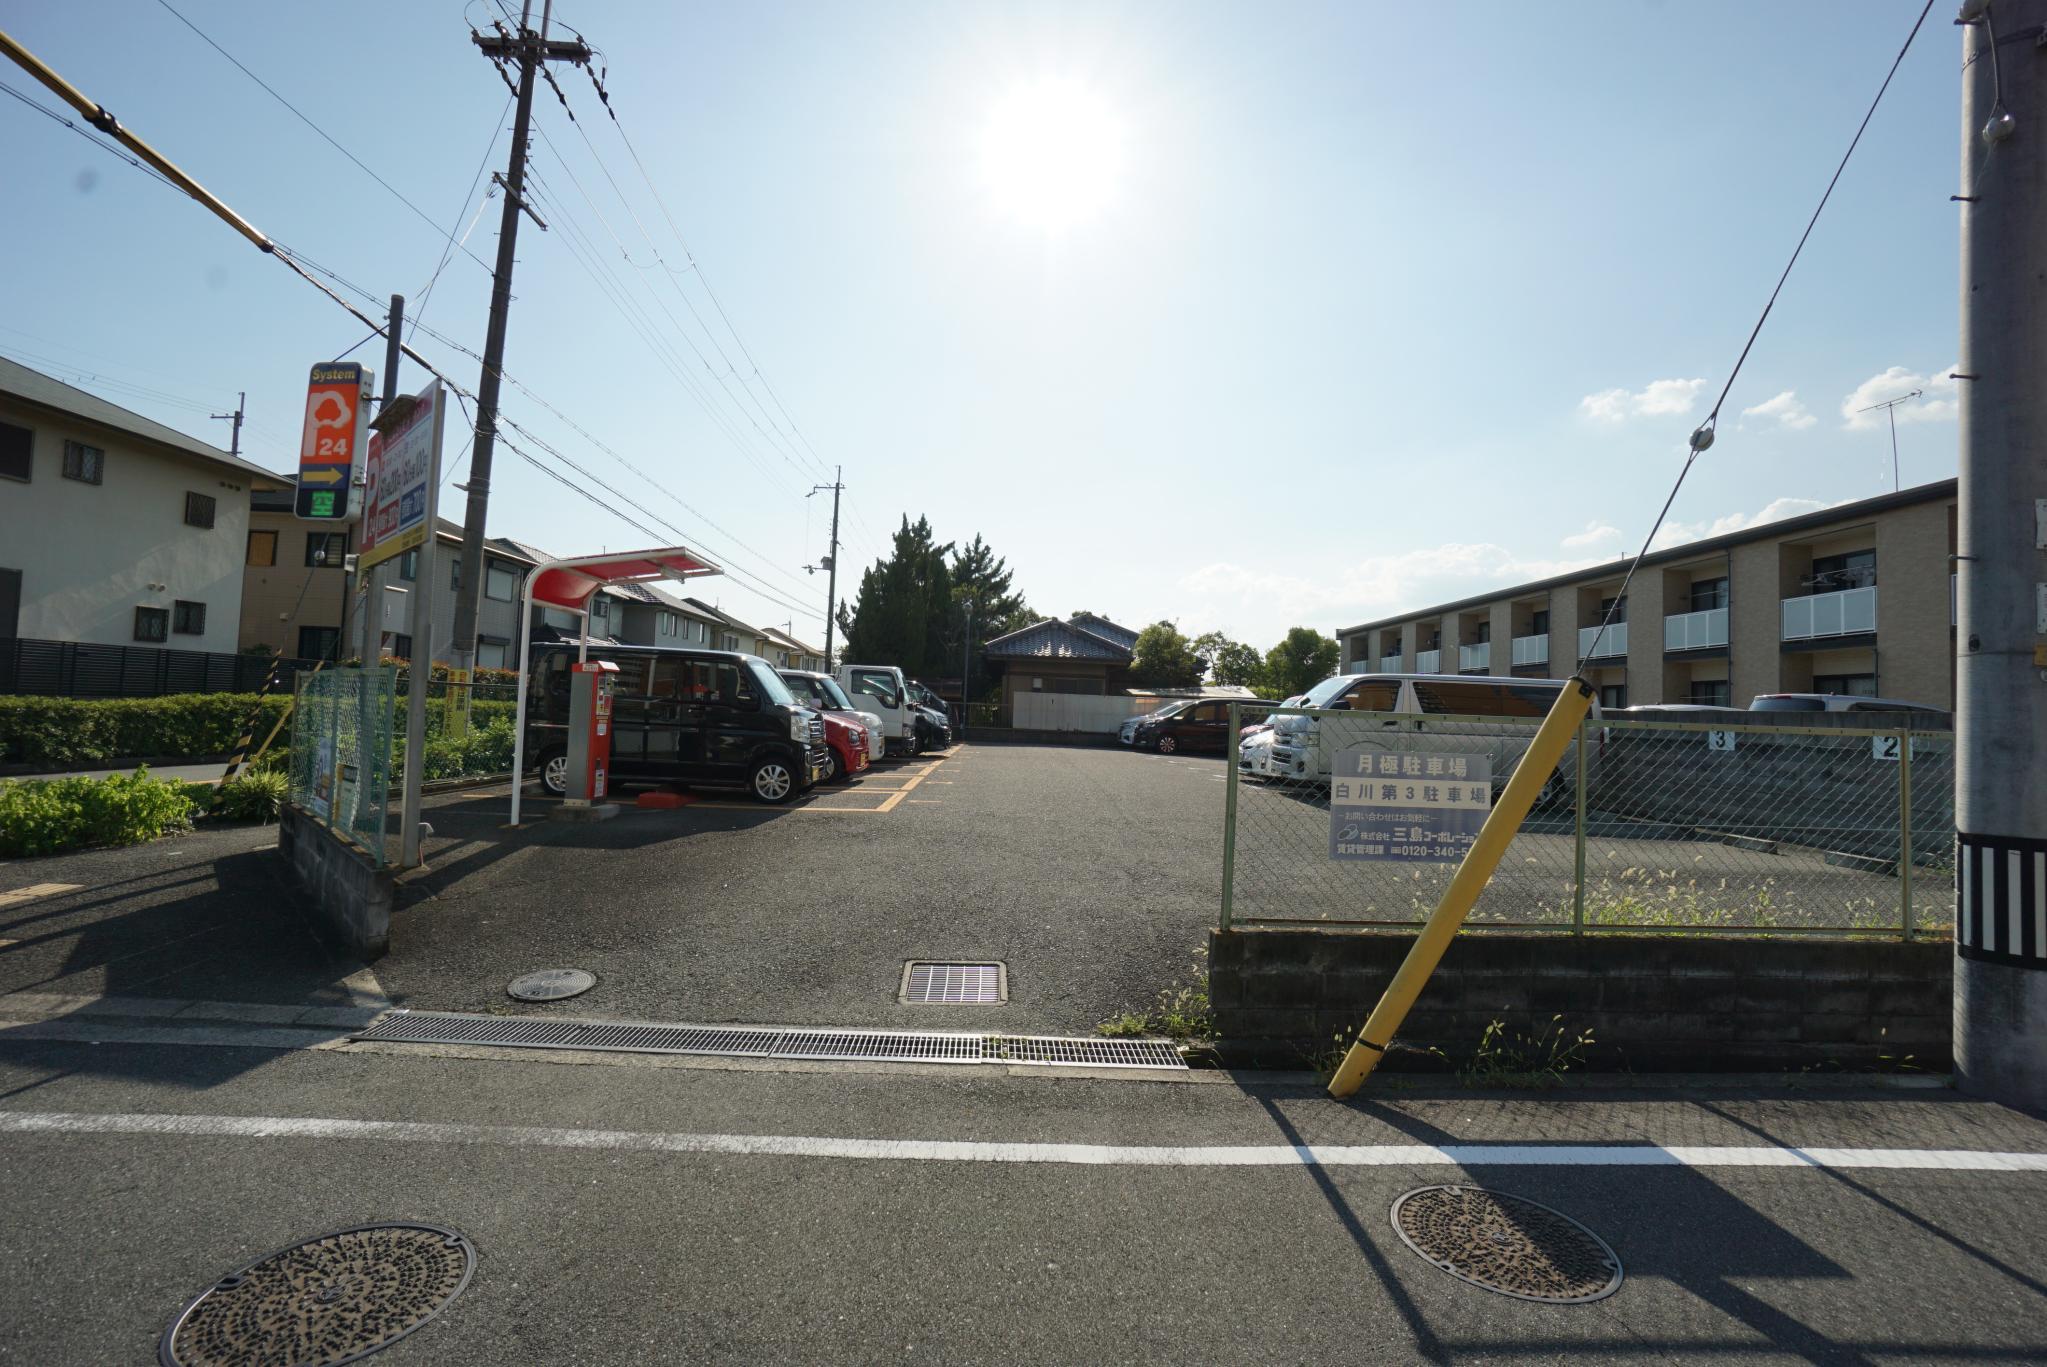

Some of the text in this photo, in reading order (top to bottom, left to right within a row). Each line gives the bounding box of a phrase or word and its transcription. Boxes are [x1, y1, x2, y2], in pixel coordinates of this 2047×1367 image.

[312, 369, 356, 382] System
[320, 438, 348, 456] 24
[1716, 731, 1725, 747] 3
[1883, 736, 1898, 757] 2
[1357, 754, 1467, 777] 月極駐車場
[1335, 783, 1486, 803] 白川第3駐車場
[1392, 826, 1479, 843] 三島コーポレーショ
[1402, 845, 1470, 857] 0120-340-5
